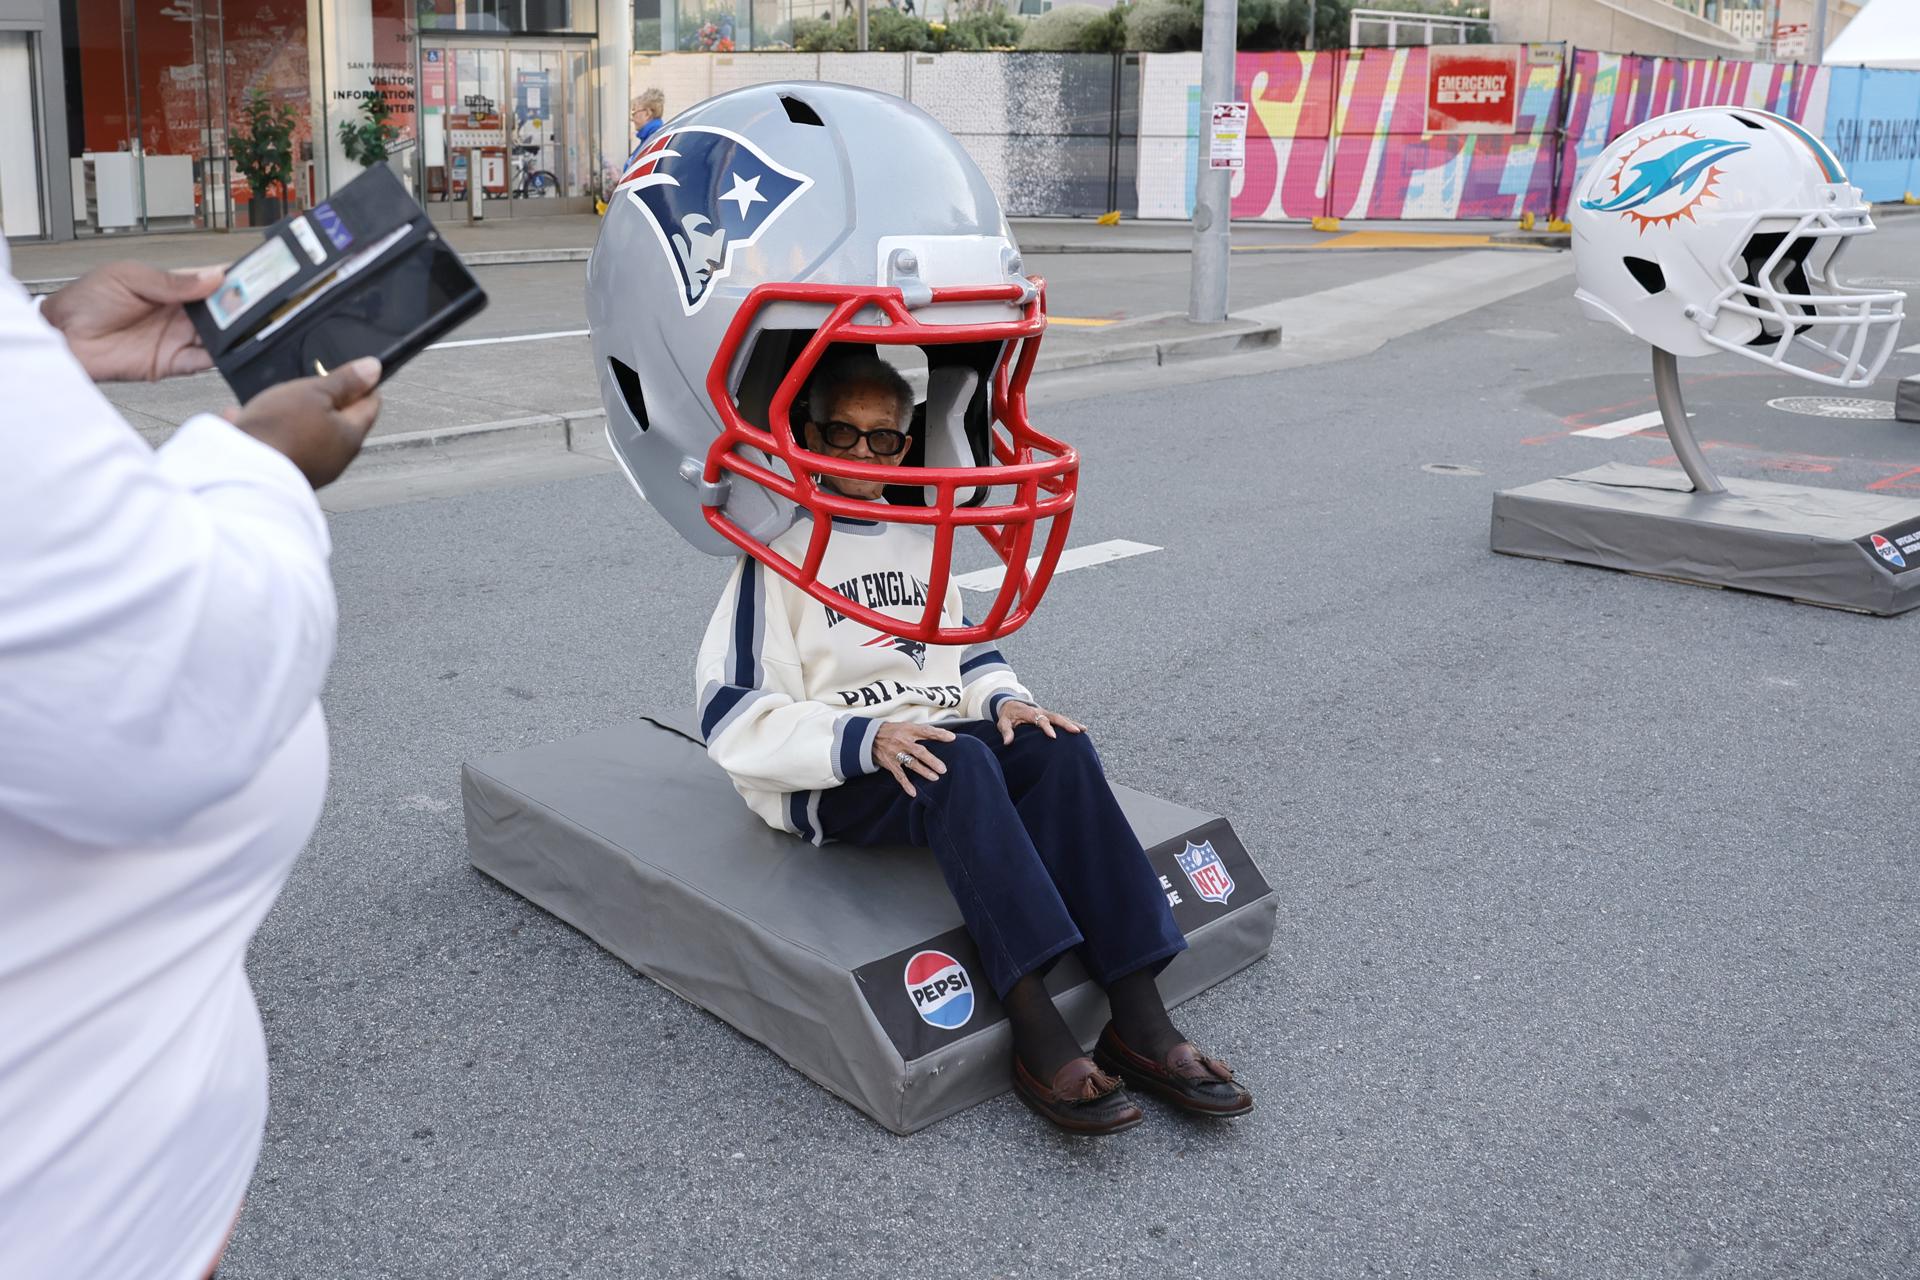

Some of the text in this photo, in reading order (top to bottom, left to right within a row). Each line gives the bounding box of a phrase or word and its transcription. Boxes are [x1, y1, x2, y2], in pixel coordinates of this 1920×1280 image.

[347, 62, 414, 70] SAN FRANCISCO
[368, 76, 415, 86] VISITOR
[1438, 75, 1508, 92] EMERGENCY
[333, 90, 415, 100] INFORMATION
[1437, 91, 1506, 104] EXIT
[372, 104, 415, 113] CENTER
[1834, 117, 1863, 163] SAN
[861, 571, 947, 613] ENGLA
[1191, 864, 1229, 896] NFL
[912, 971, 968, 1007] PEPSI
